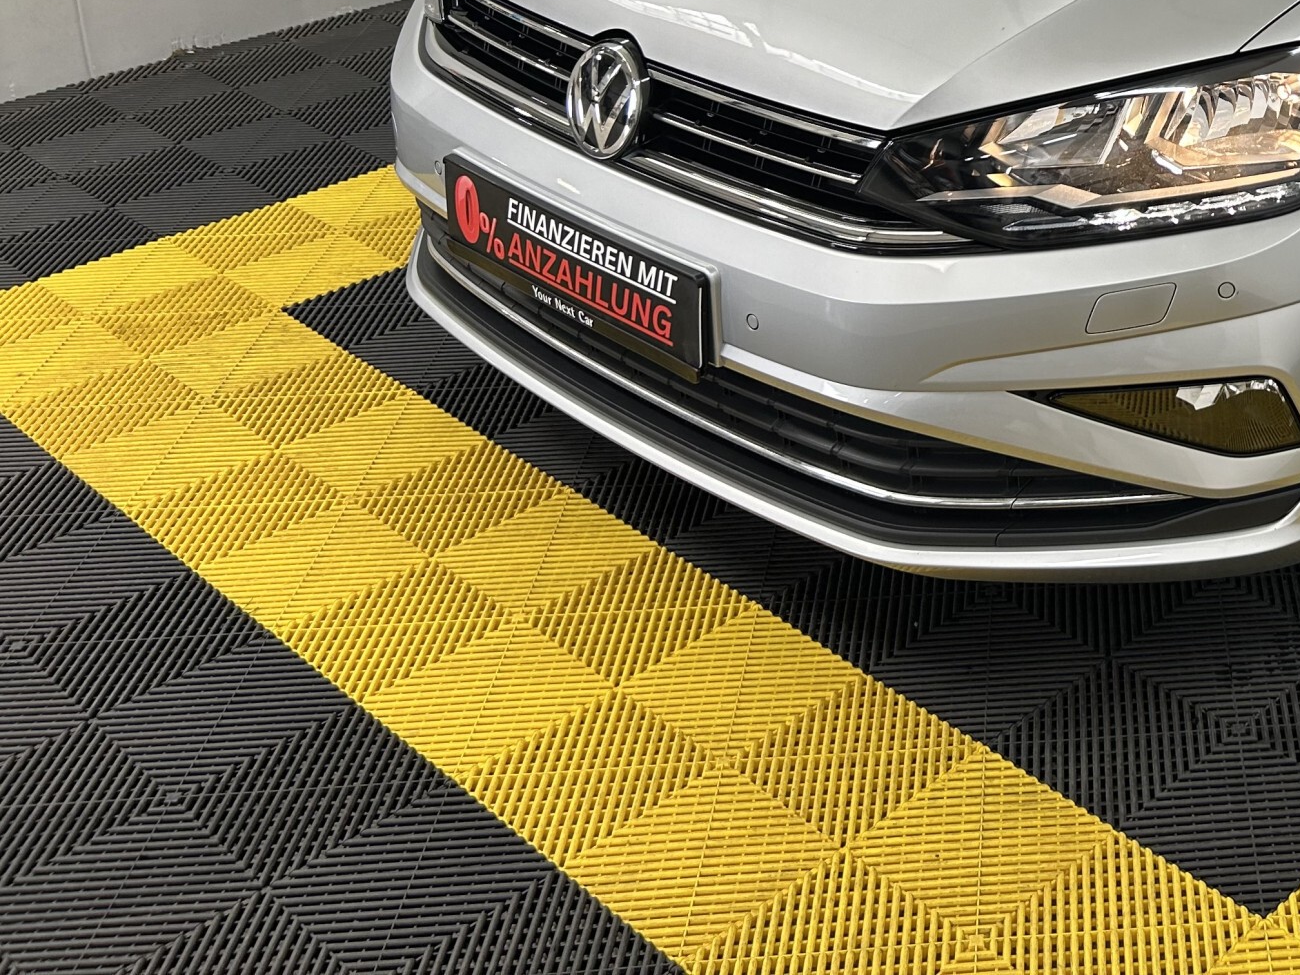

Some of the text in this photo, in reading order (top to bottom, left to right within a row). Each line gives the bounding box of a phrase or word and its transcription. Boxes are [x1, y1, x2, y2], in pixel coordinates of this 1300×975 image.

[455, 175, 505, 260] 0%
[507, 197, 678, 297] FINANZIEREN MIT
[507, 232, 673, 339] ANZAHLUNG
[531, 284, 594, 328] Your Next Car
